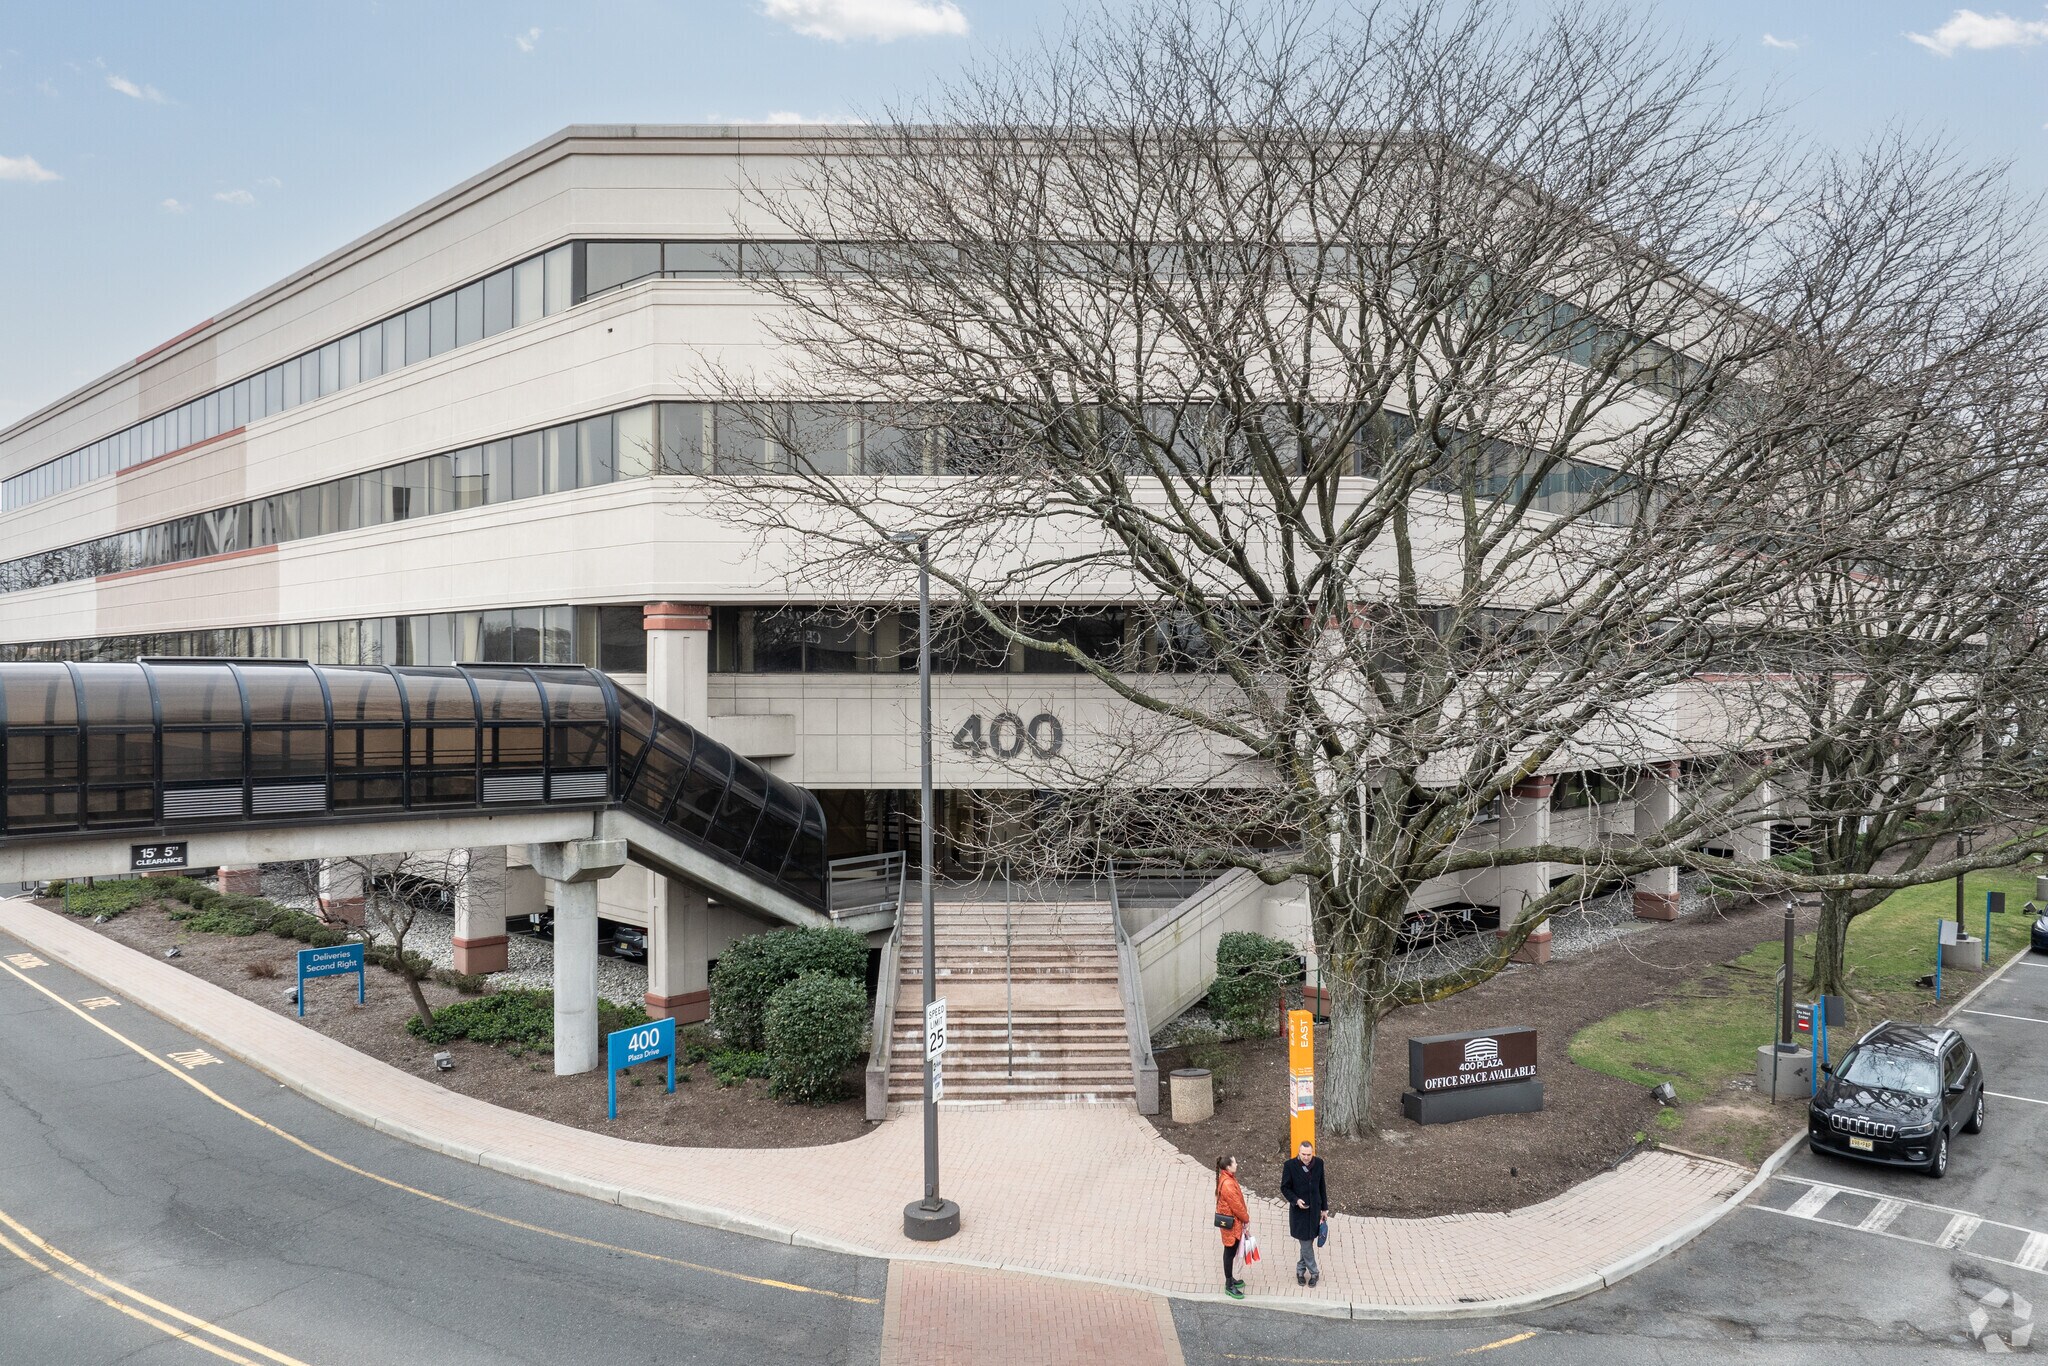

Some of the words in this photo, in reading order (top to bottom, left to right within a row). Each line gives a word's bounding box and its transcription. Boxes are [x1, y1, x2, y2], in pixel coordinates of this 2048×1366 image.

[952, 712, 1063, 760] 400
[136, 857, 183, 866] CLEARANCE
[313, 952, 350, 961] Deliveries
[306, 962, 335, 972] Second
[338, 960, 357, 969] Right
[928, 1005, 944, 1019] SPEED
[930, 1016, 943, 1030] LIMIT
[628, 1028, 660, 1051] 400
[930, 1028, 944, 1053] 25
[1300, 1020, 1308, 1048] EAST
[628, 1054, 643, 1062] Plaza
[644, 1049, 660, 1058] Drive
[1459, 1061, 1476, 1071] 400
[1476, 1058, 1504, 1070] PLAZA
[1425, 1076, 1458, 1089] OFFICE
[1460, 1072, 1488, 1084] SPACE
[1489, 1065, 1536, 1080] AVAILABLE
